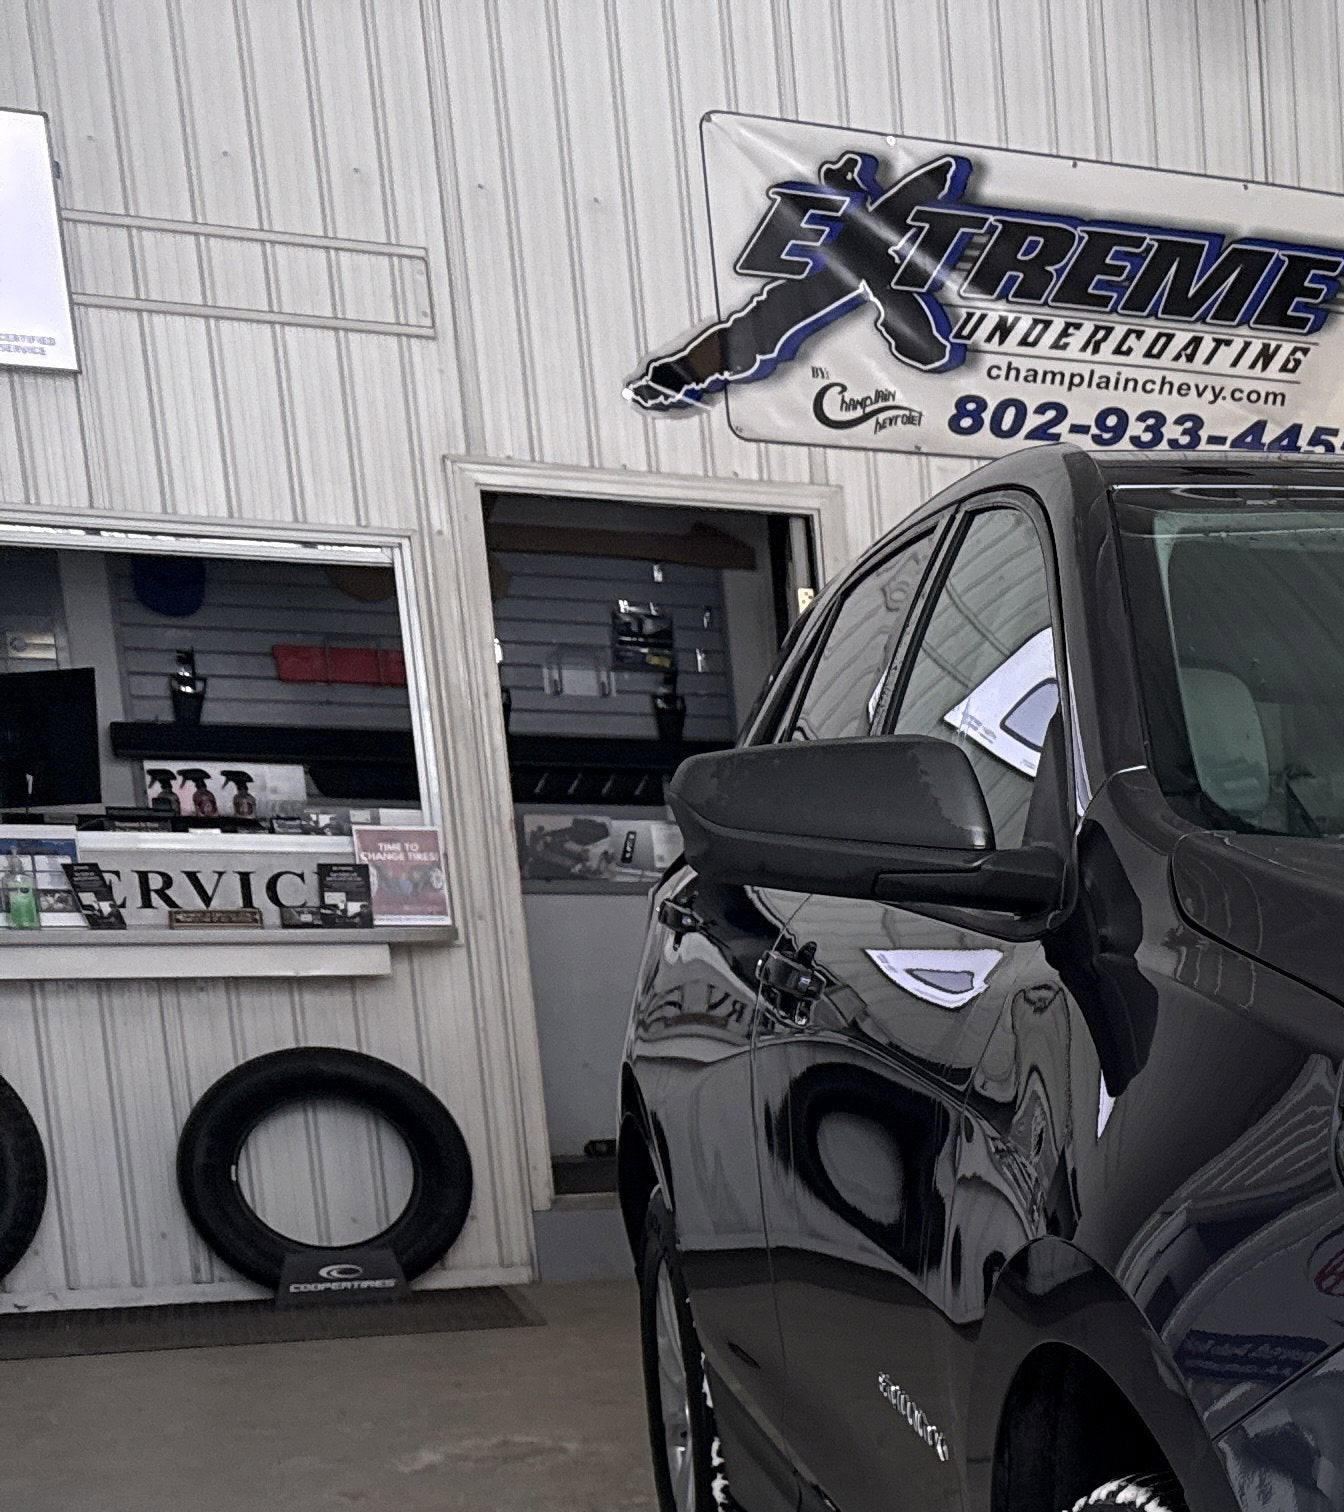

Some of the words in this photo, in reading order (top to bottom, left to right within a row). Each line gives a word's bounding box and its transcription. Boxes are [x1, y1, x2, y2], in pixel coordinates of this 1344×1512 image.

[951, 310, 1311, 375] UNDERCOATING
[811, 366, 830, 380] BY:
[986, 360, 1287, 408] champlainchevy.com
[360, 852, 404, 863] CHANGE
[378, 842, 400, 850] TIME
[404, 842, 419, 850] TO
[100, 869, 320, 910] ERVIC
